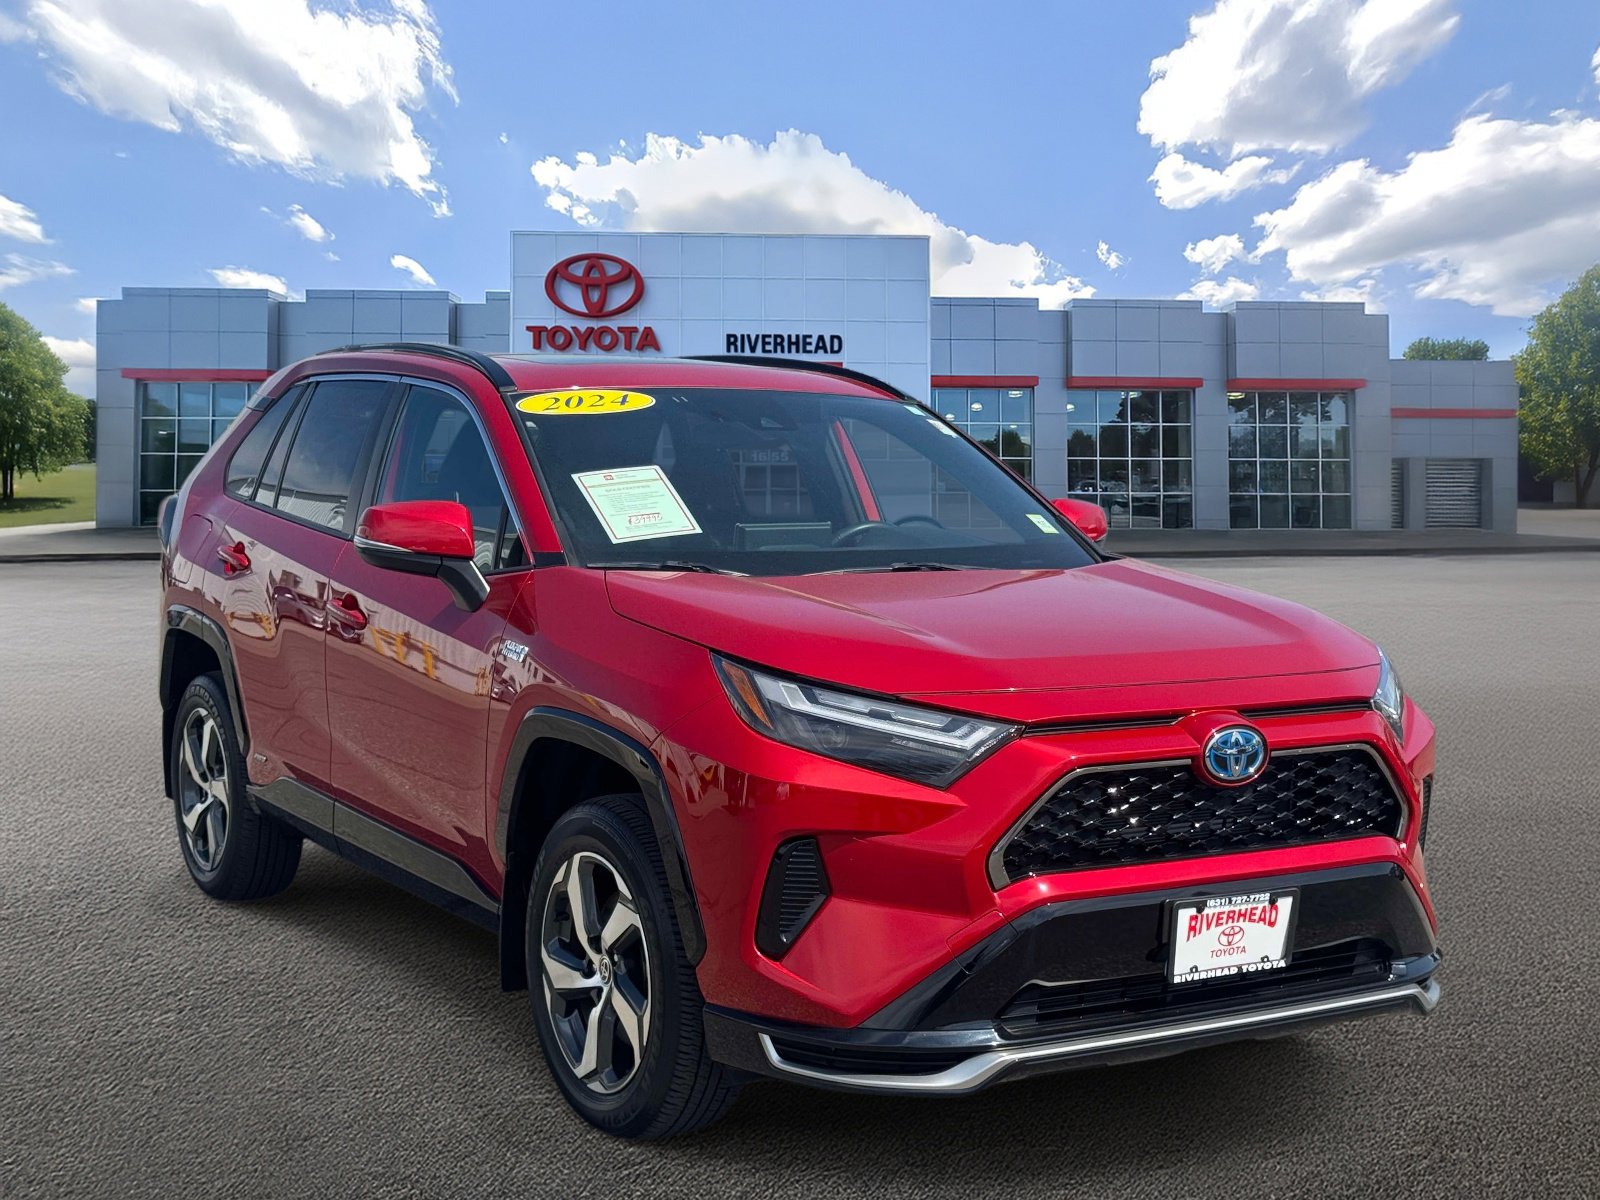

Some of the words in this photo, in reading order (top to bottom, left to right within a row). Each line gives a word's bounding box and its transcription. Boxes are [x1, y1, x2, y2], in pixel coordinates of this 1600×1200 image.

[526, 325, 661, 352] TOYOTA
[726, 333, 844, 355] RIVERHEAD
[543, 394, 629, 412] 2024
[1206, 897, 1229, 907] (631)
[1186, 904, 1279, 942] RIVERHEAD
[1210, 946, 1247, 958] TOYOTA
[1173, 966, 1239, 983] RIVERHEAD
[1242, 959, 1287, 973] TOYOTA
